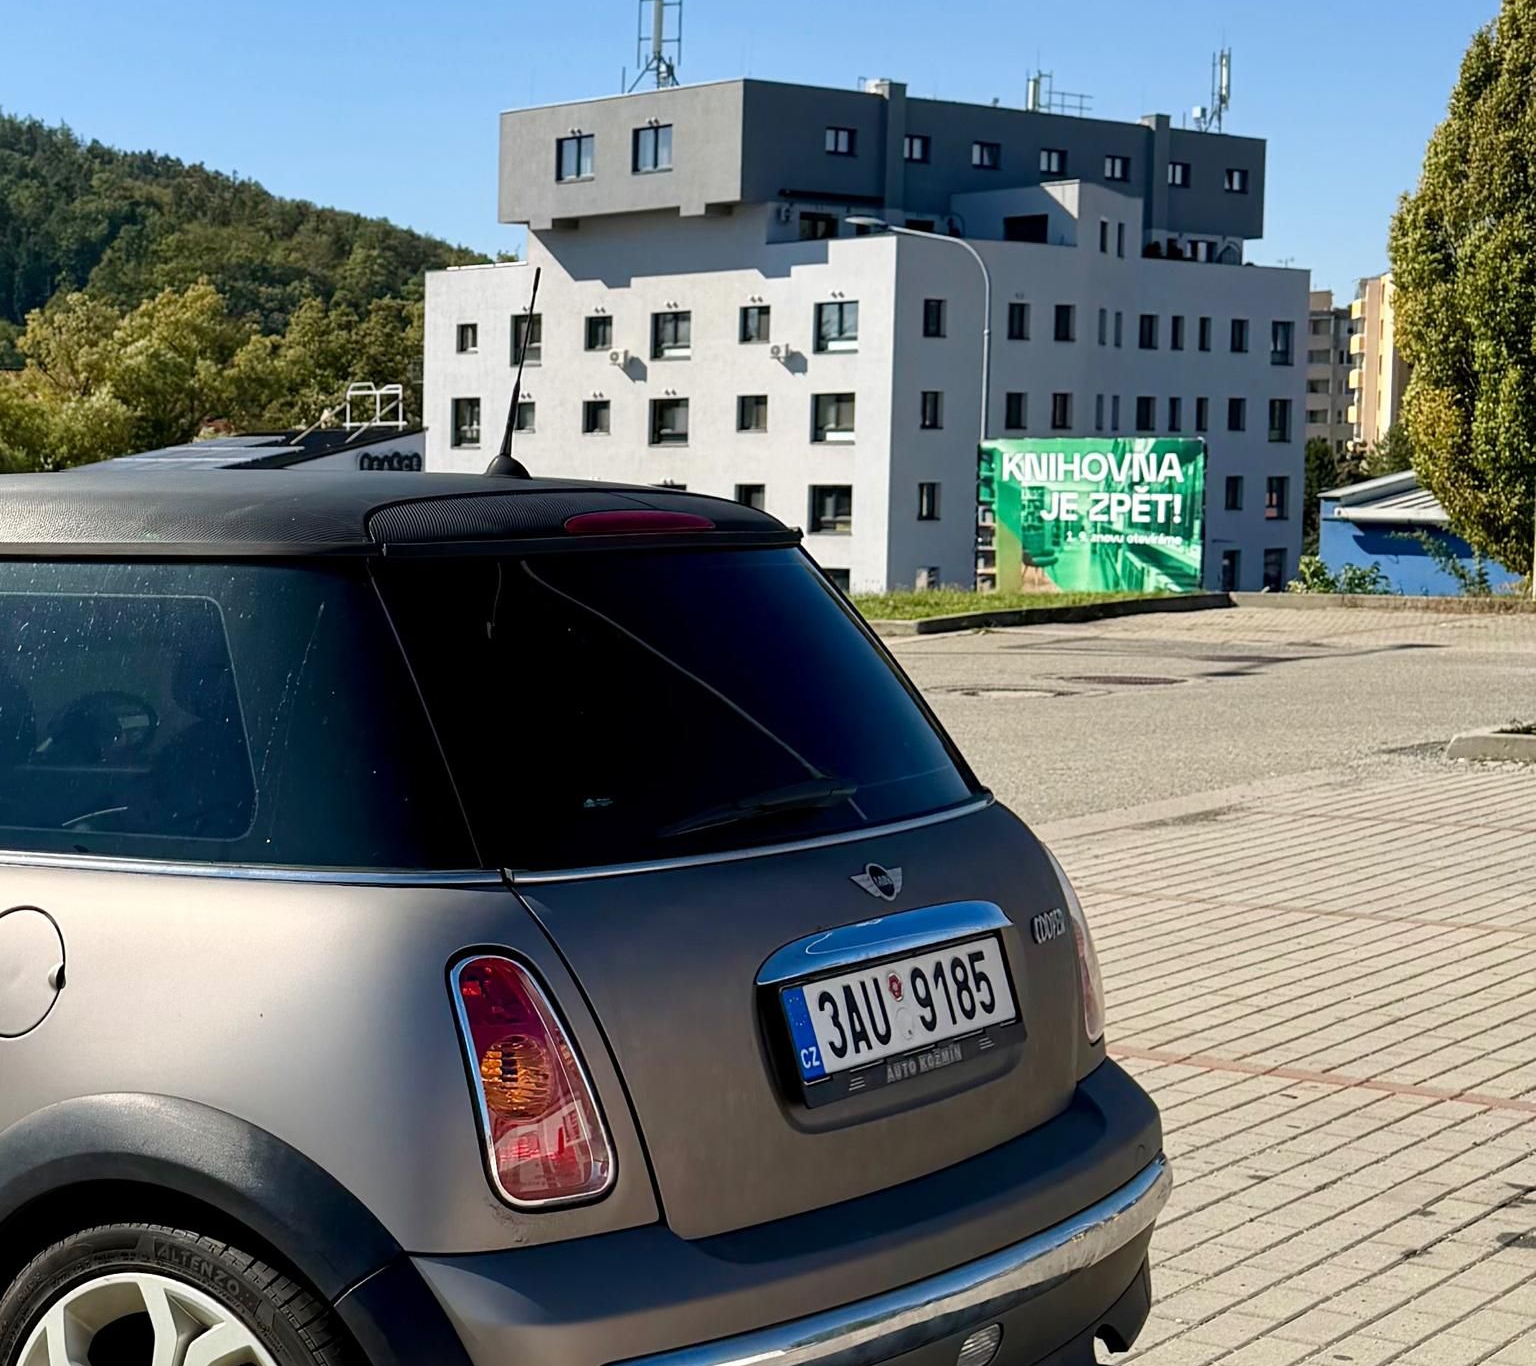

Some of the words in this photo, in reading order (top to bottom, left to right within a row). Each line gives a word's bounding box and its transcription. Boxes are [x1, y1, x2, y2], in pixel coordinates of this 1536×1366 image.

[1001, 452, 1184, 482] KNIHOVNA
[1040, 491, 1079, 521] JE
[1088, 485, 1183, 524] ZPĚT!
[818, 977, 892, 1059] 3AU
[911, 951, 996, 1033] 9185
[800, 1045, 821, 1070] CZ
[887, 1059, 917, 1083] AUTO
